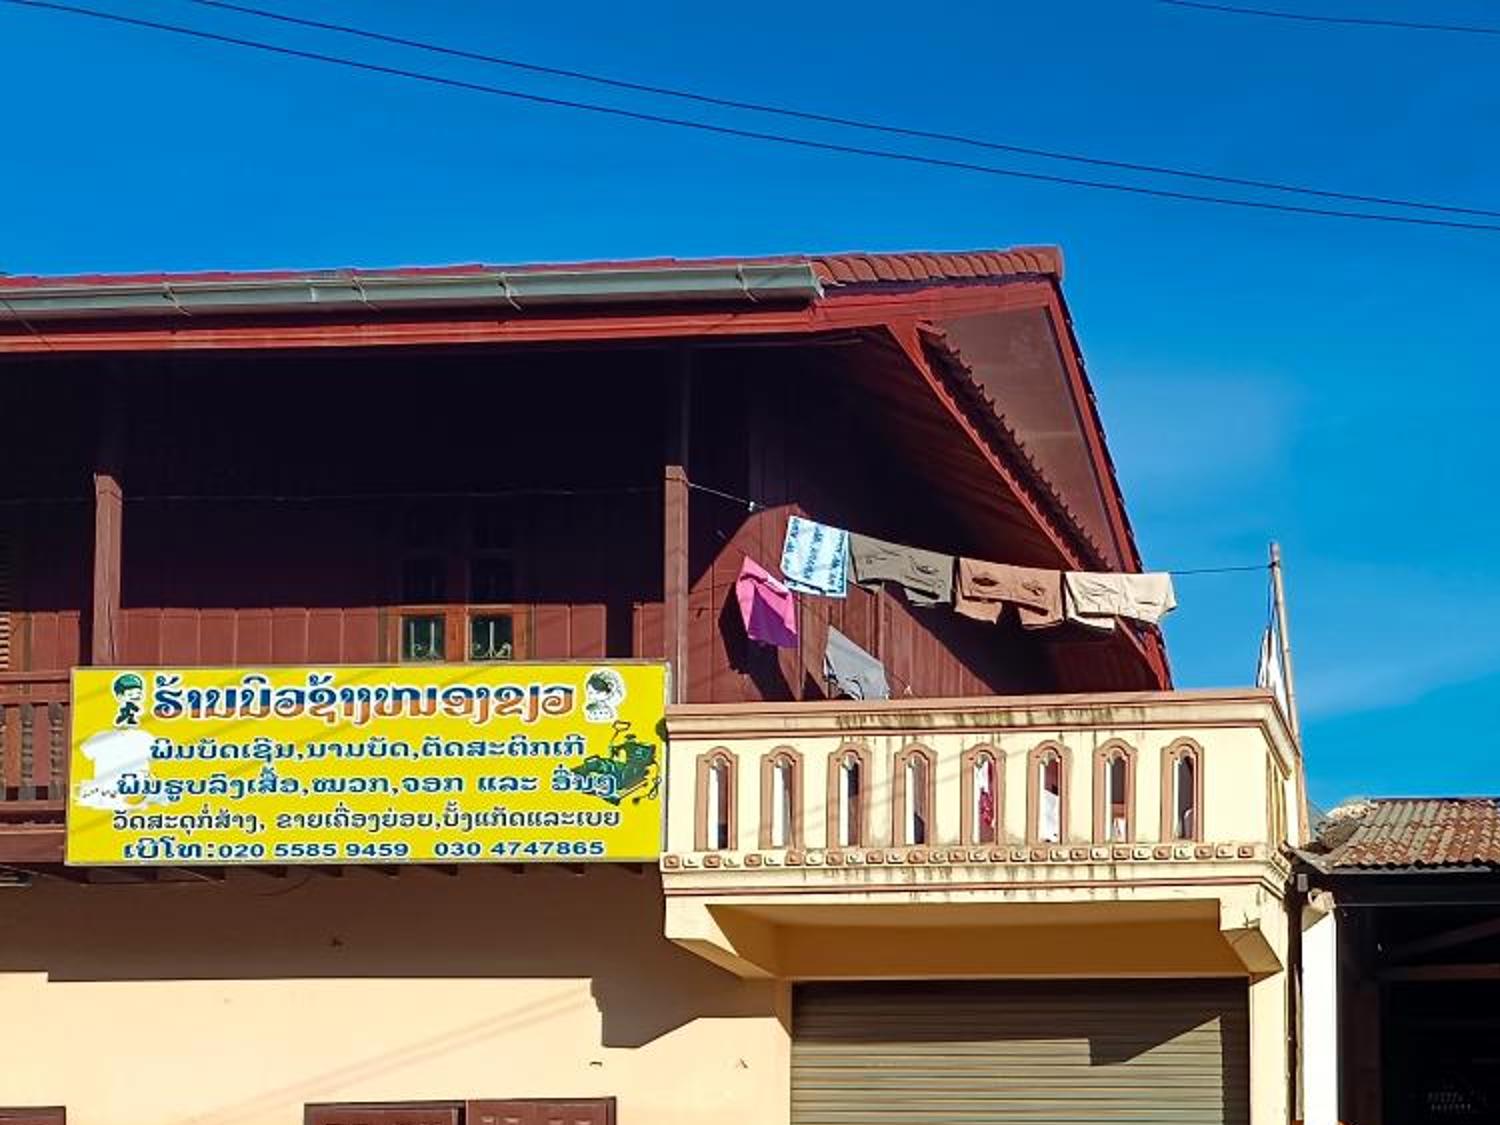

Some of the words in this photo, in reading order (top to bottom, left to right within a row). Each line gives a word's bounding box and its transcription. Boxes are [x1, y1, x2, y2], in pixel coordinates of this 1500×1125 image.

[478, 774, 538, 795] ແລະ
[274, 842, 338, 859] 5585
[345, 841, 410, 859] 9459
[434, 841, 482, 858] 030
[490, 840, 605, 858] 4747865
